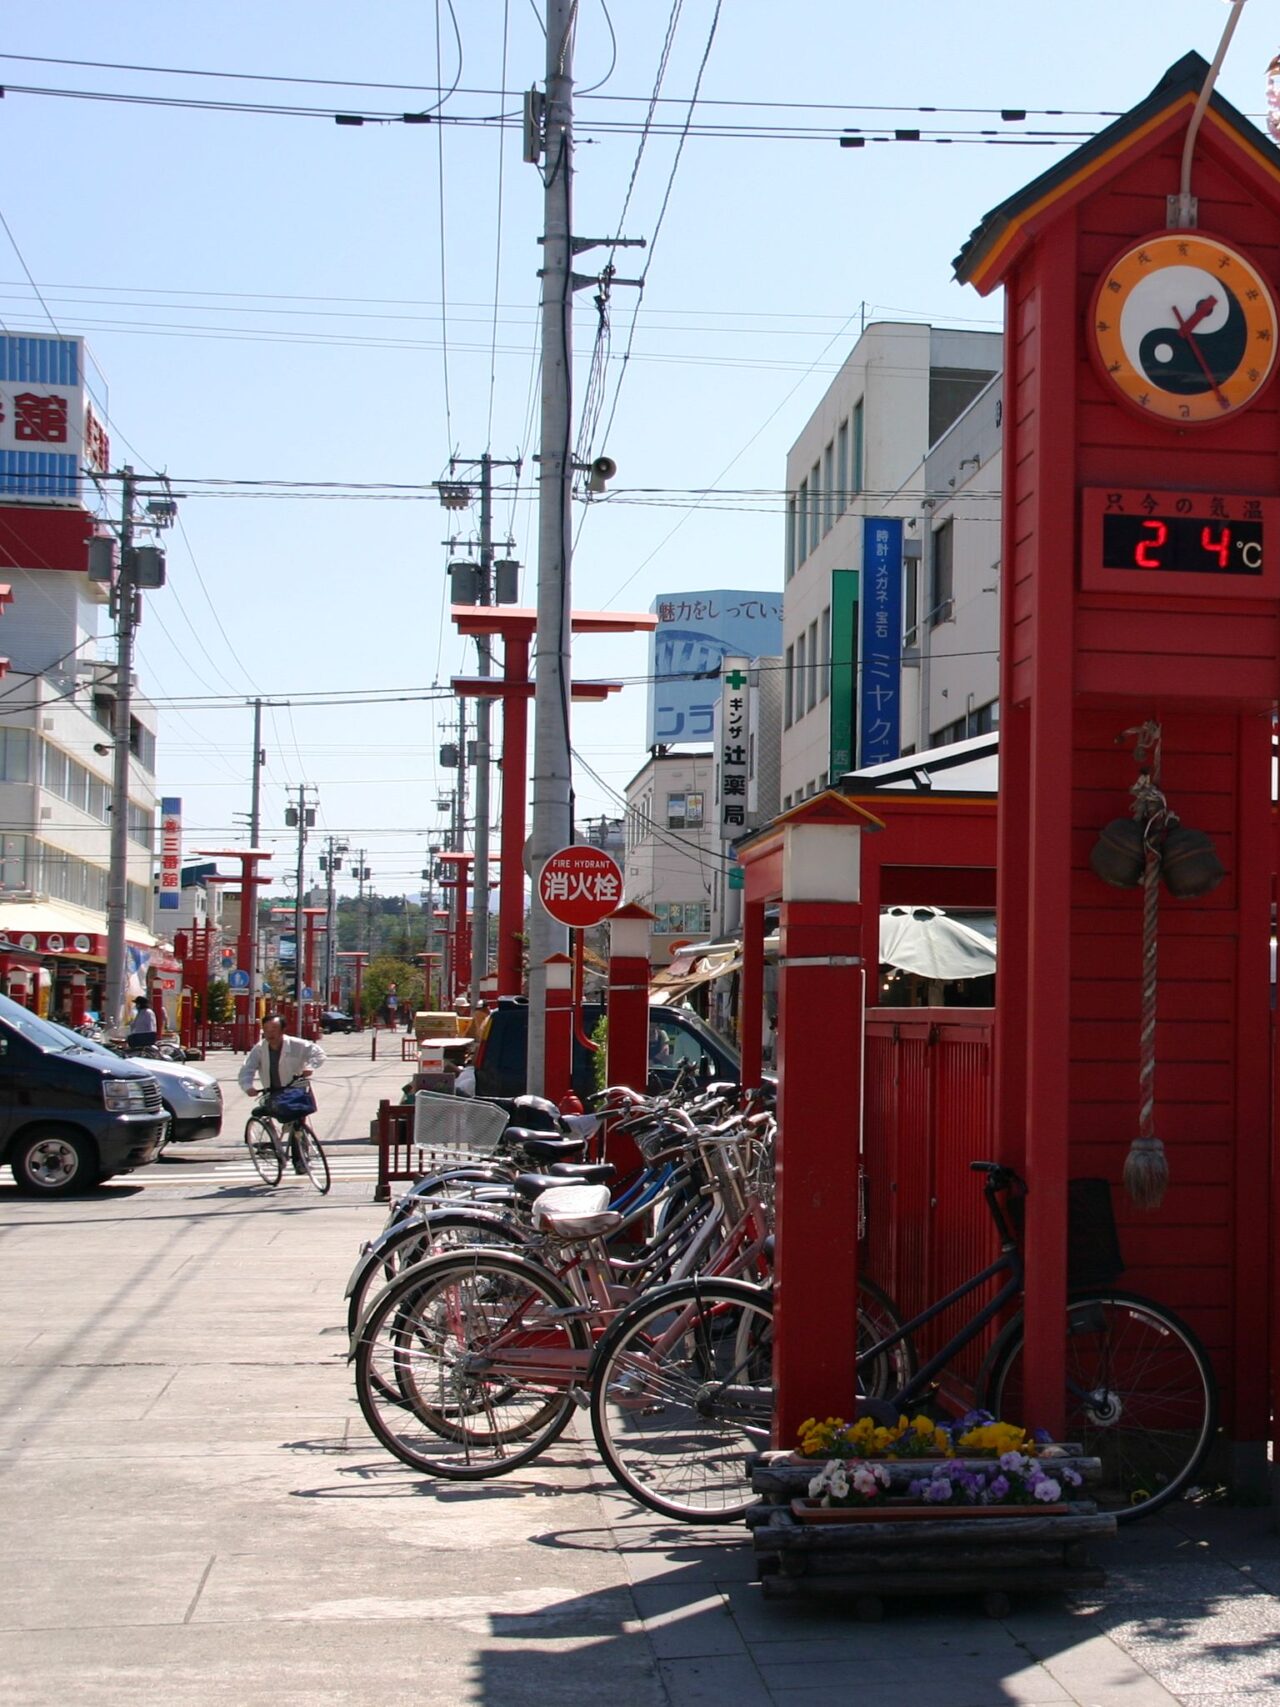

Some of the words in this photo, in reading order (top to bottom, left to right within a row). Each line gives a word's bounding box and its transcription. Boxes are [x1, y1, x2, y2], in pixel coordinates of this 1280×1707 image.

[1105, 493, 1264, 519] 只今の気温
[553, 859, 571, 868] FIRE
[574, 860, 611, 869] HYDRANT
[544, 871, 619, 901] 消火栓
